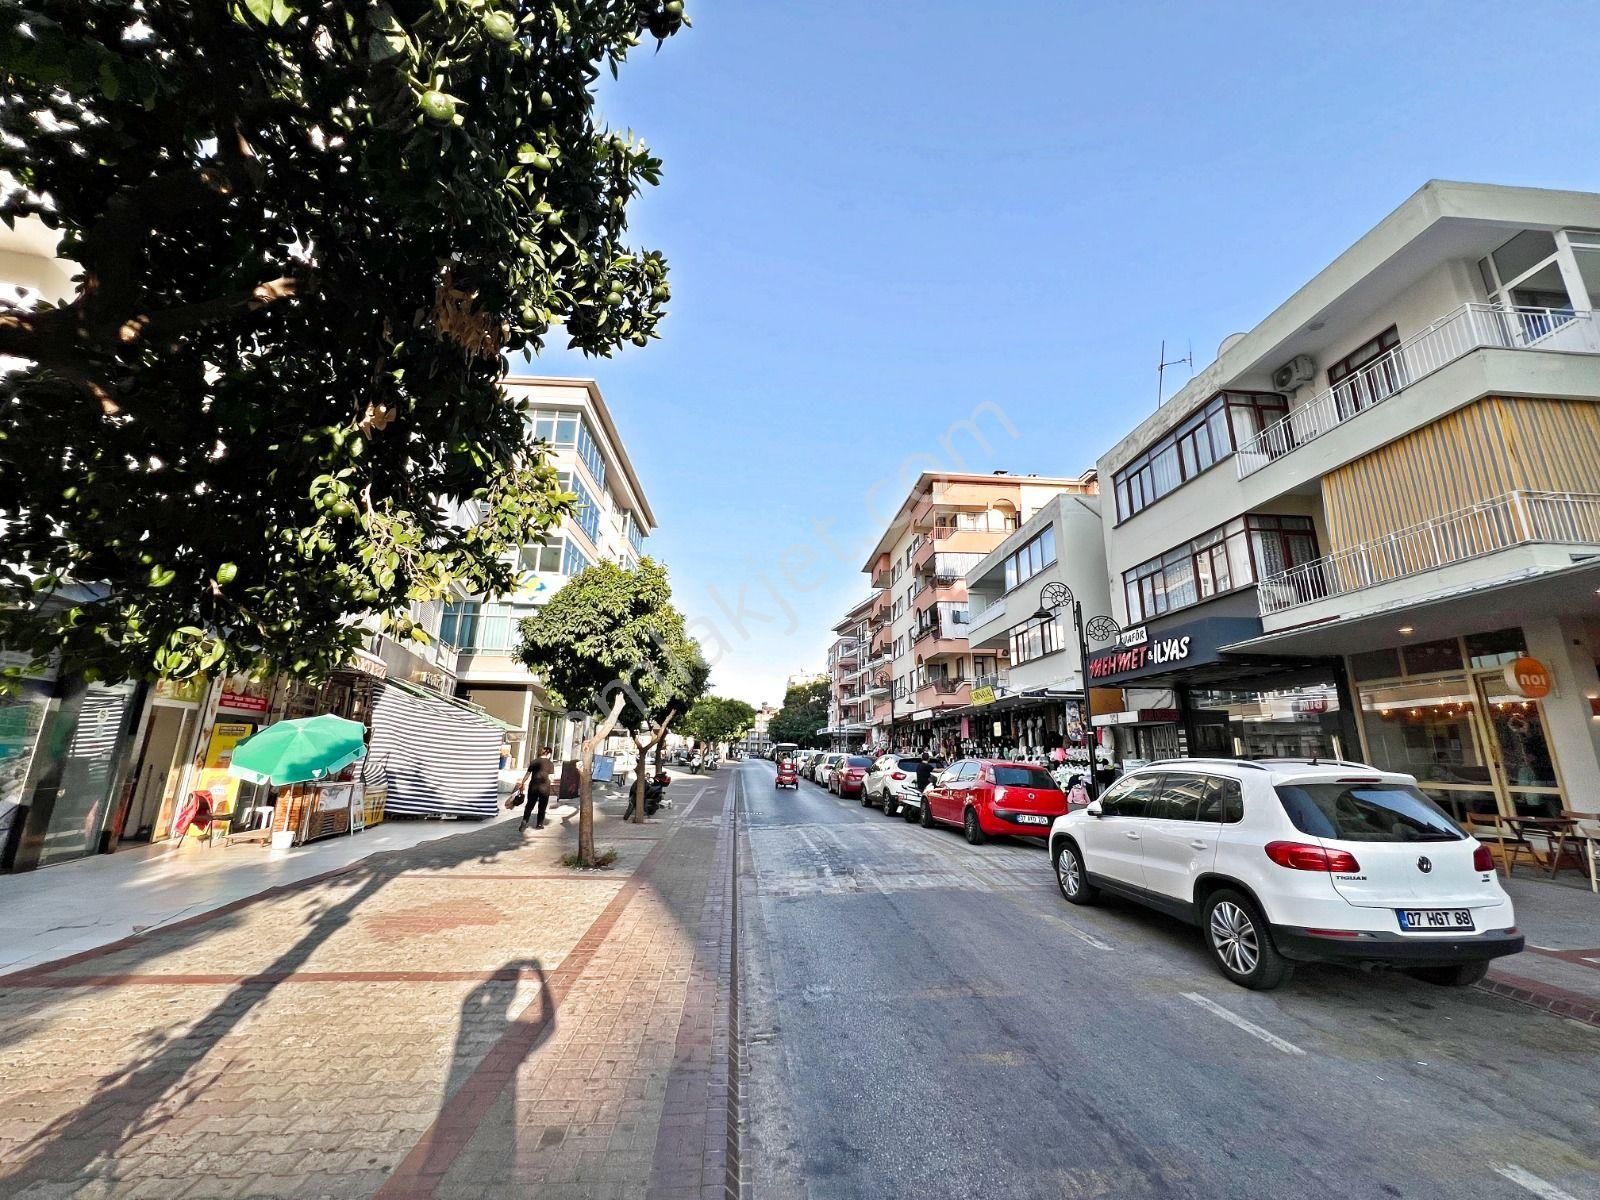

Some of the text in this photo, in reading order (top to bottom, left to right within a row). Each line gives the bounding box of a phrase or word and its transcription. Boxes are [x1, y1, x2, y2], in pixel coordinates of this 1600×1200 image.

[1121, 629, 1145, 645] UAFÖR
[1089, 636, 1190, 679] MEHMET & İLYAS
[1407, 912, 1421, 926] 07
[1427, 911, 1450, 926] HGT
[1455, 911, 1471, 925] 88
